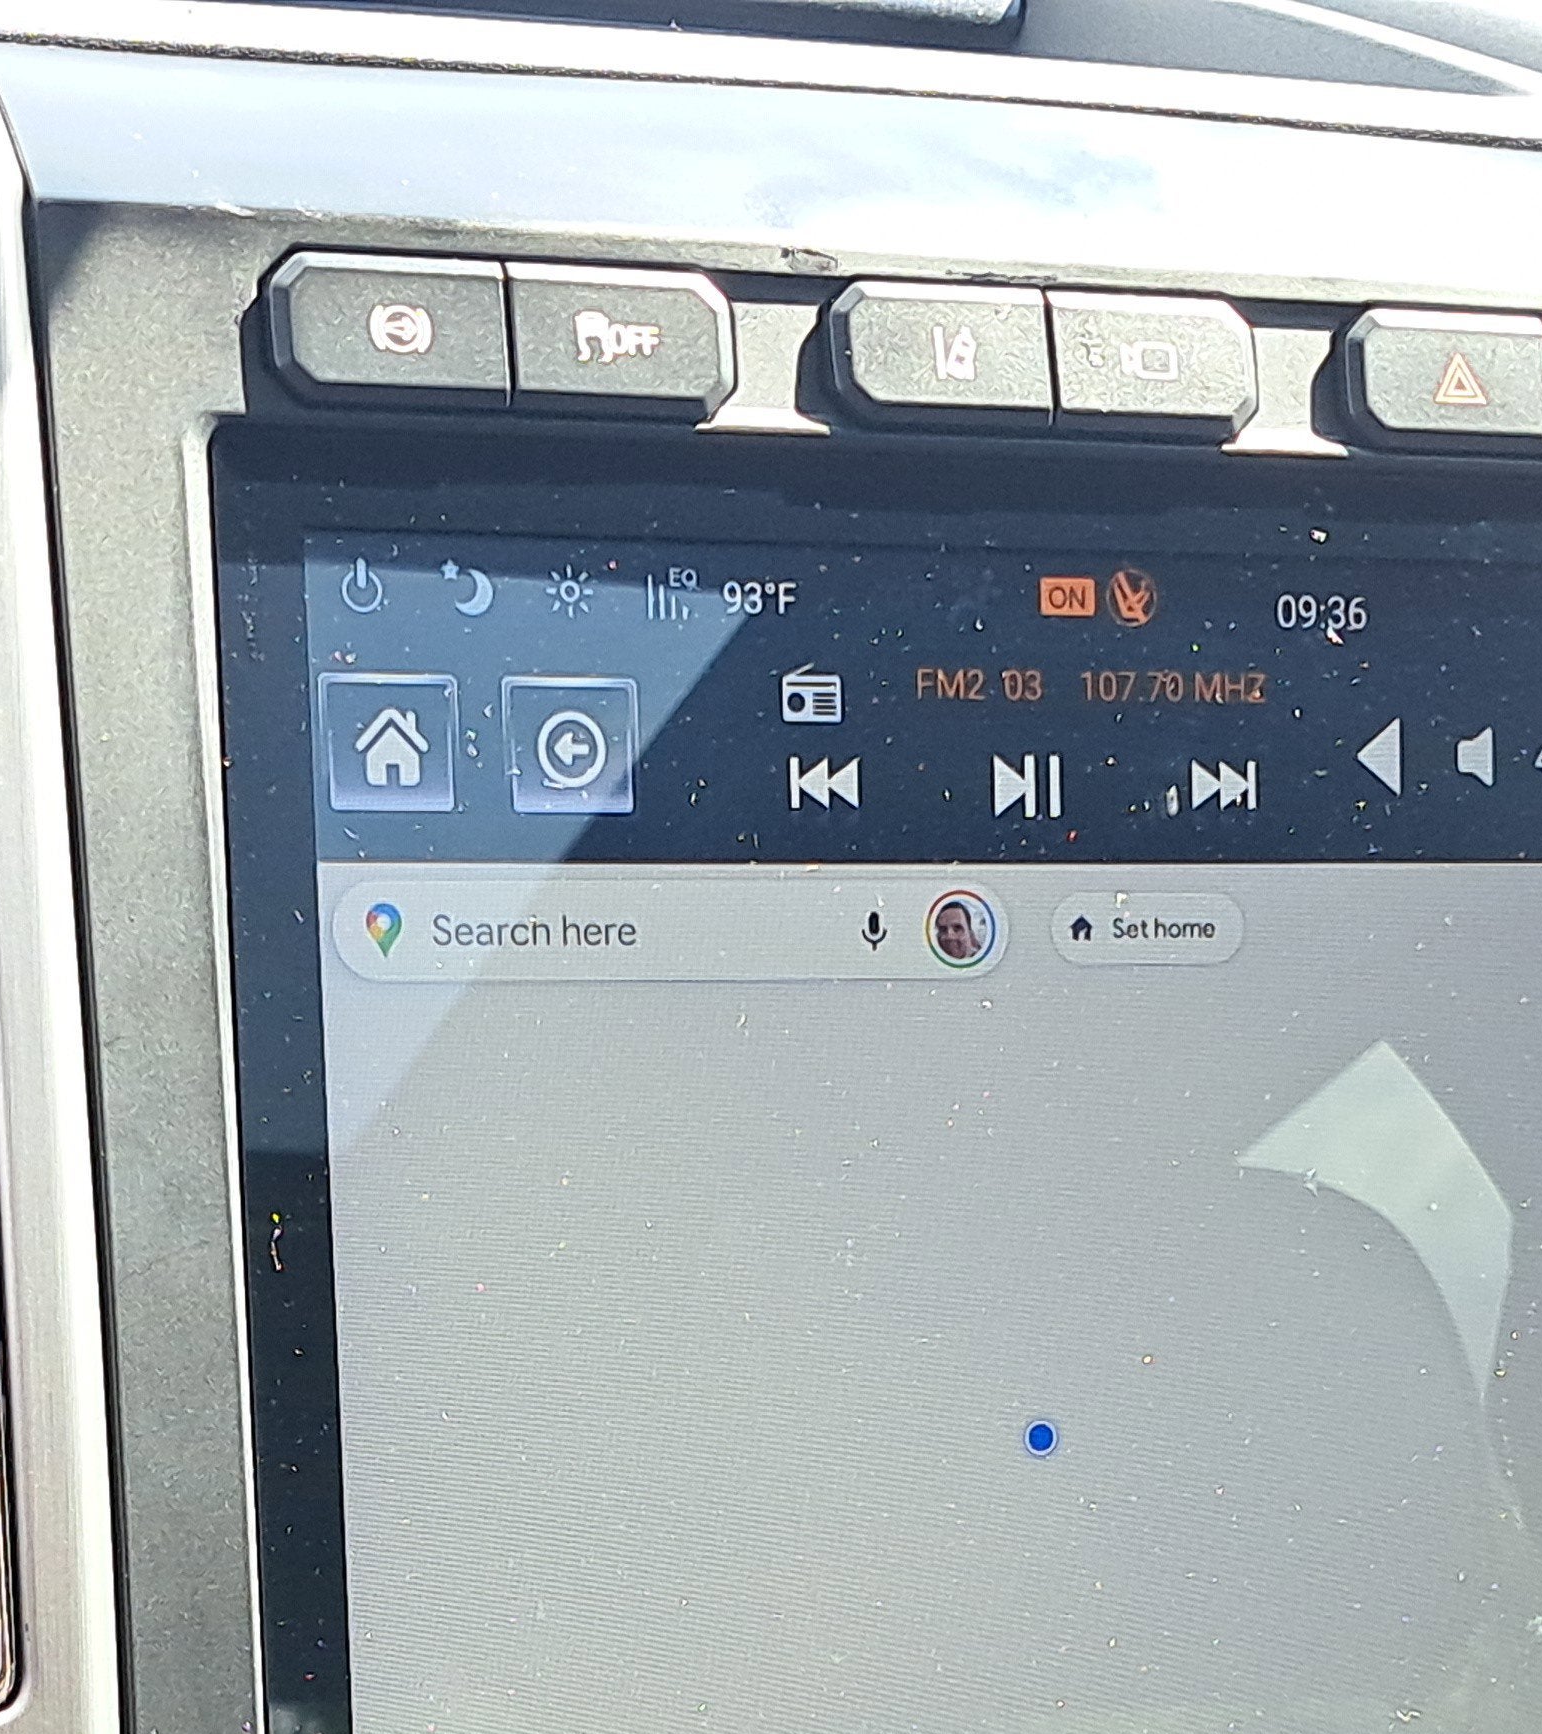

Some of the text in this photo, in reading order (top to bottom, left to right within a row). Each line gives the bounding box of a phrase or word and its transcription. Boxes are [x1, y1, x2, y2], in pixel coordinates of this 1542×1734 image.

[611, 324, 659, 357] OFF
[668, 568, 699, 588] EQ
[722, 580, 797, 616] 93°F
[1047, 586, 1086, 609] ON
[1275, 593, 1367, 631] 09:36
[916, 668, 1266, 703] FM2 03 107.70 MHZ
[431, 913, 637, 948] Search here
[1112, 915, 1216, 941] Set home
